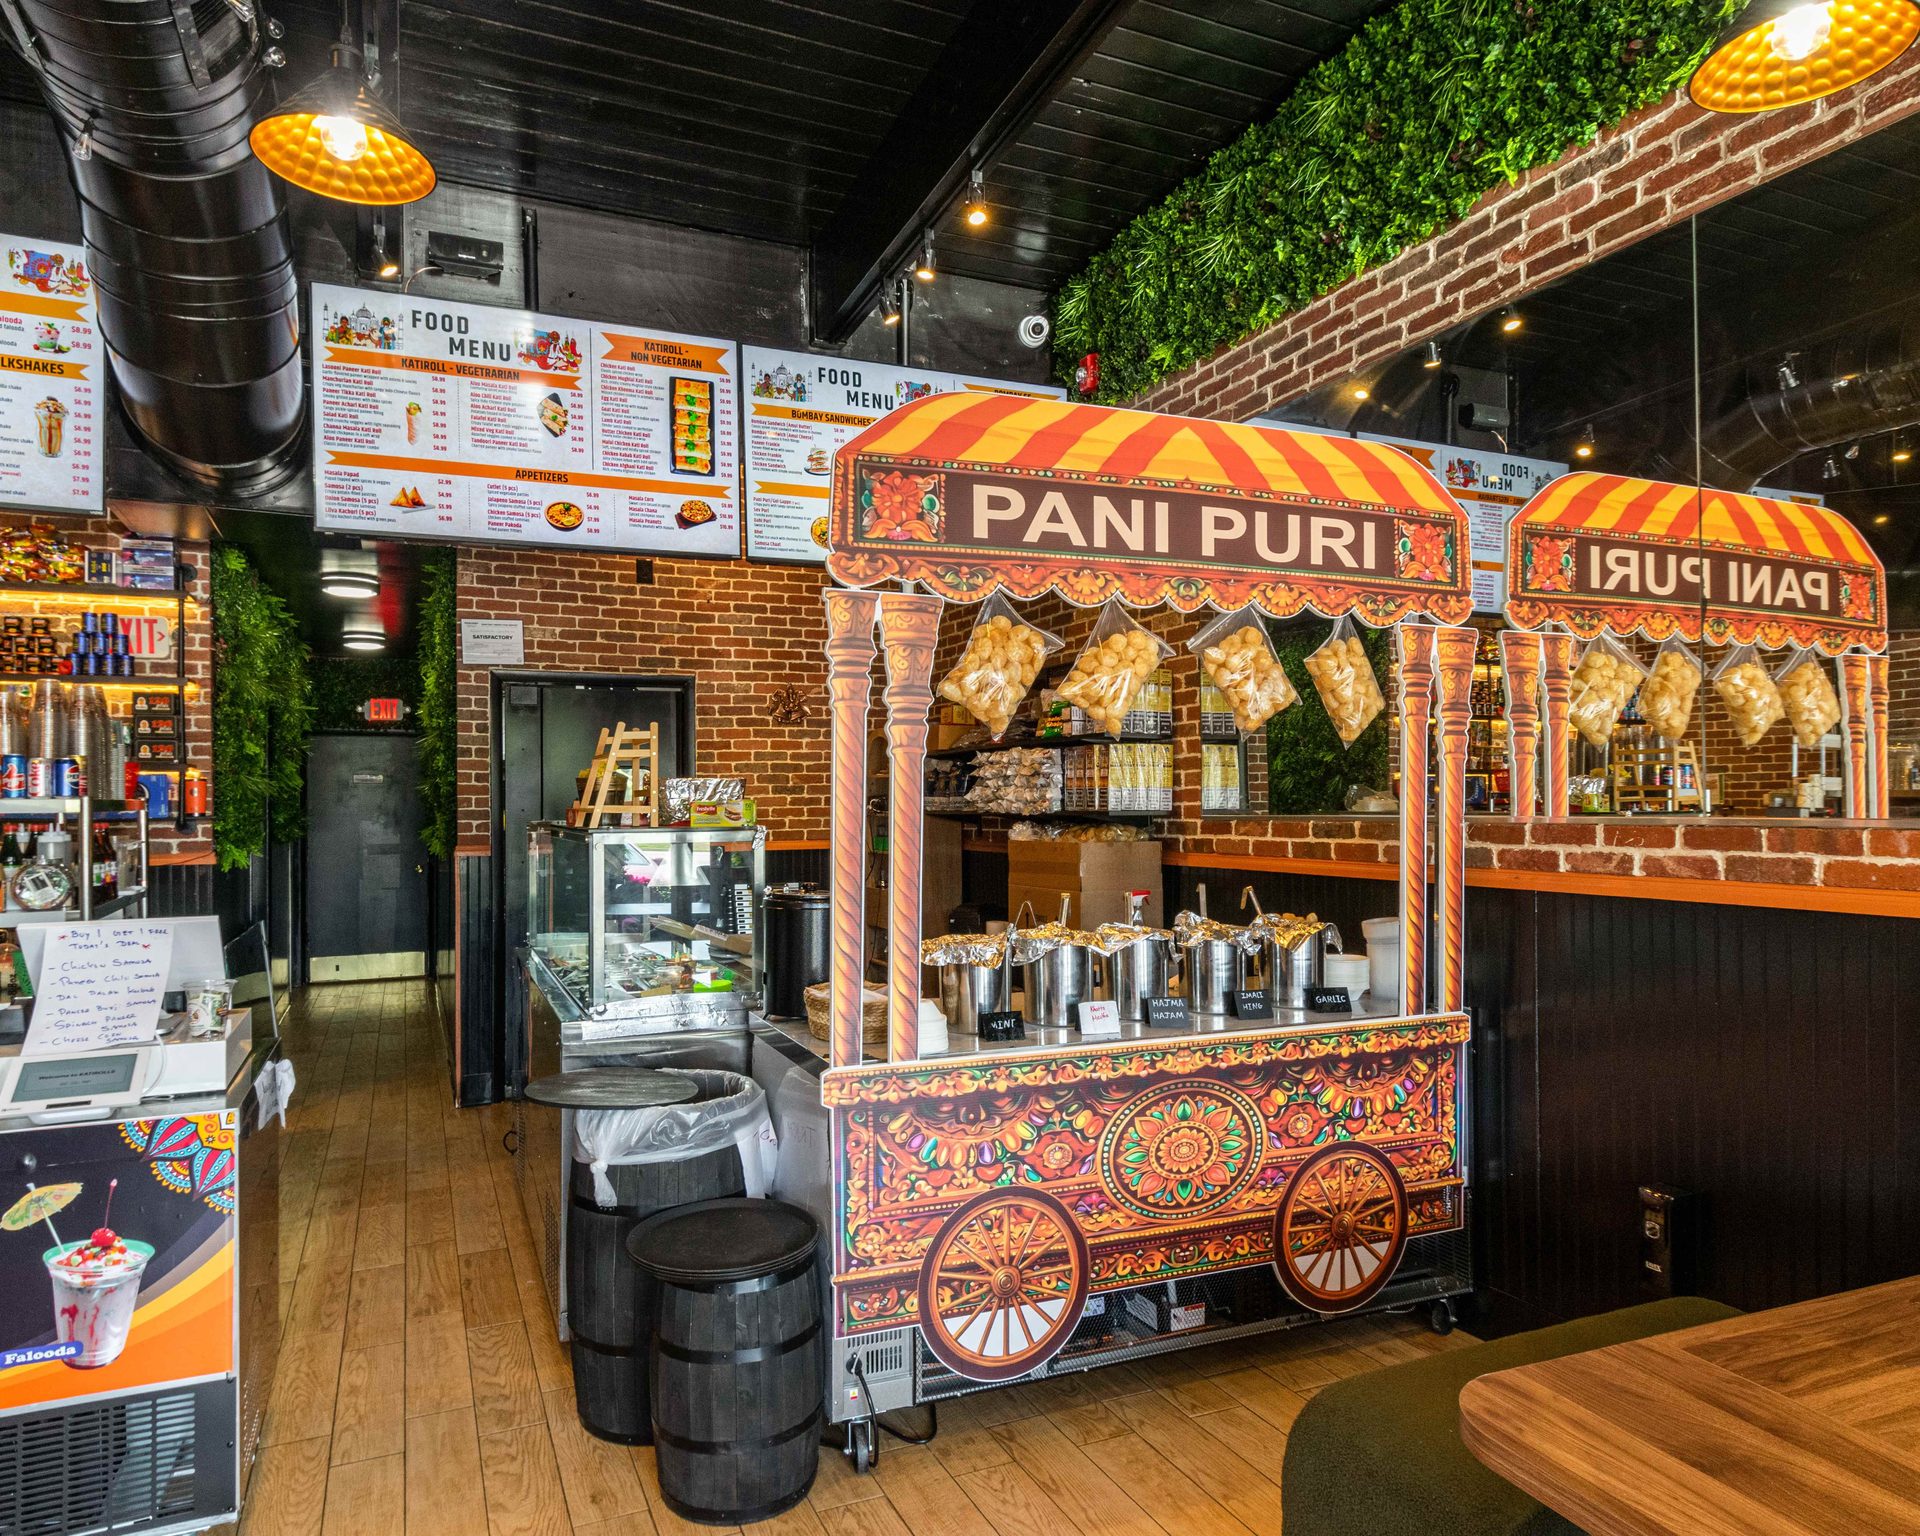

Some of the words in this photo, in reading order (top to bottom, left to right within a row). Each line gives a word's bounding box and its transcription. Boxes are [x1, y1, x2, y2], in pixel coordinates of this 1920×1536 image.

[412, 310, 469, 334] FOOD
[72, 326, 92, 334] $8.99
[72, 341, 92, 349] $8.99
[449, 336, 511, 362] MENU
[644, 342, 683, 355] KATIROLL
[631, 352, 648, 362] NON
[651, 354, 702, 368] VEGETARIAN
[401, 358, 447, 372] KATIROLL
[456, 365, 520, 380] VEGETRARIAN
[818, 367, 862, 388] FOOD
[846, 390, 894, 410] MENU
[792, 410, 823, 420] BOMBAY
[825, 414, 871, 426] SANDWICHES
[344, 471, 359, 479] Papad
[516, 470, 568, 483] APPETIZERS
[351, 484, 363, 492] pcs)
[972, 484, 1170, 552] PANI
[1200, 506, 1376, 570] PURI
[116, 618, 158, 654] XIT
[370, 698, 399, 720] EXIT
[71, 930, 90, 940] Buy
[113, 930, 134, 939] GET
[1152, 998, 1185, 1008] HAJMA
[1315, 994, 1347, 1004] GARLIC
[1242, 1003, 1263, 1011] HING
[1152, 1011, 1185, 1020] HAJAM
[990, 1018, 1016, 1030] MINT
[4, 1345, 76, 1366] Falooda
